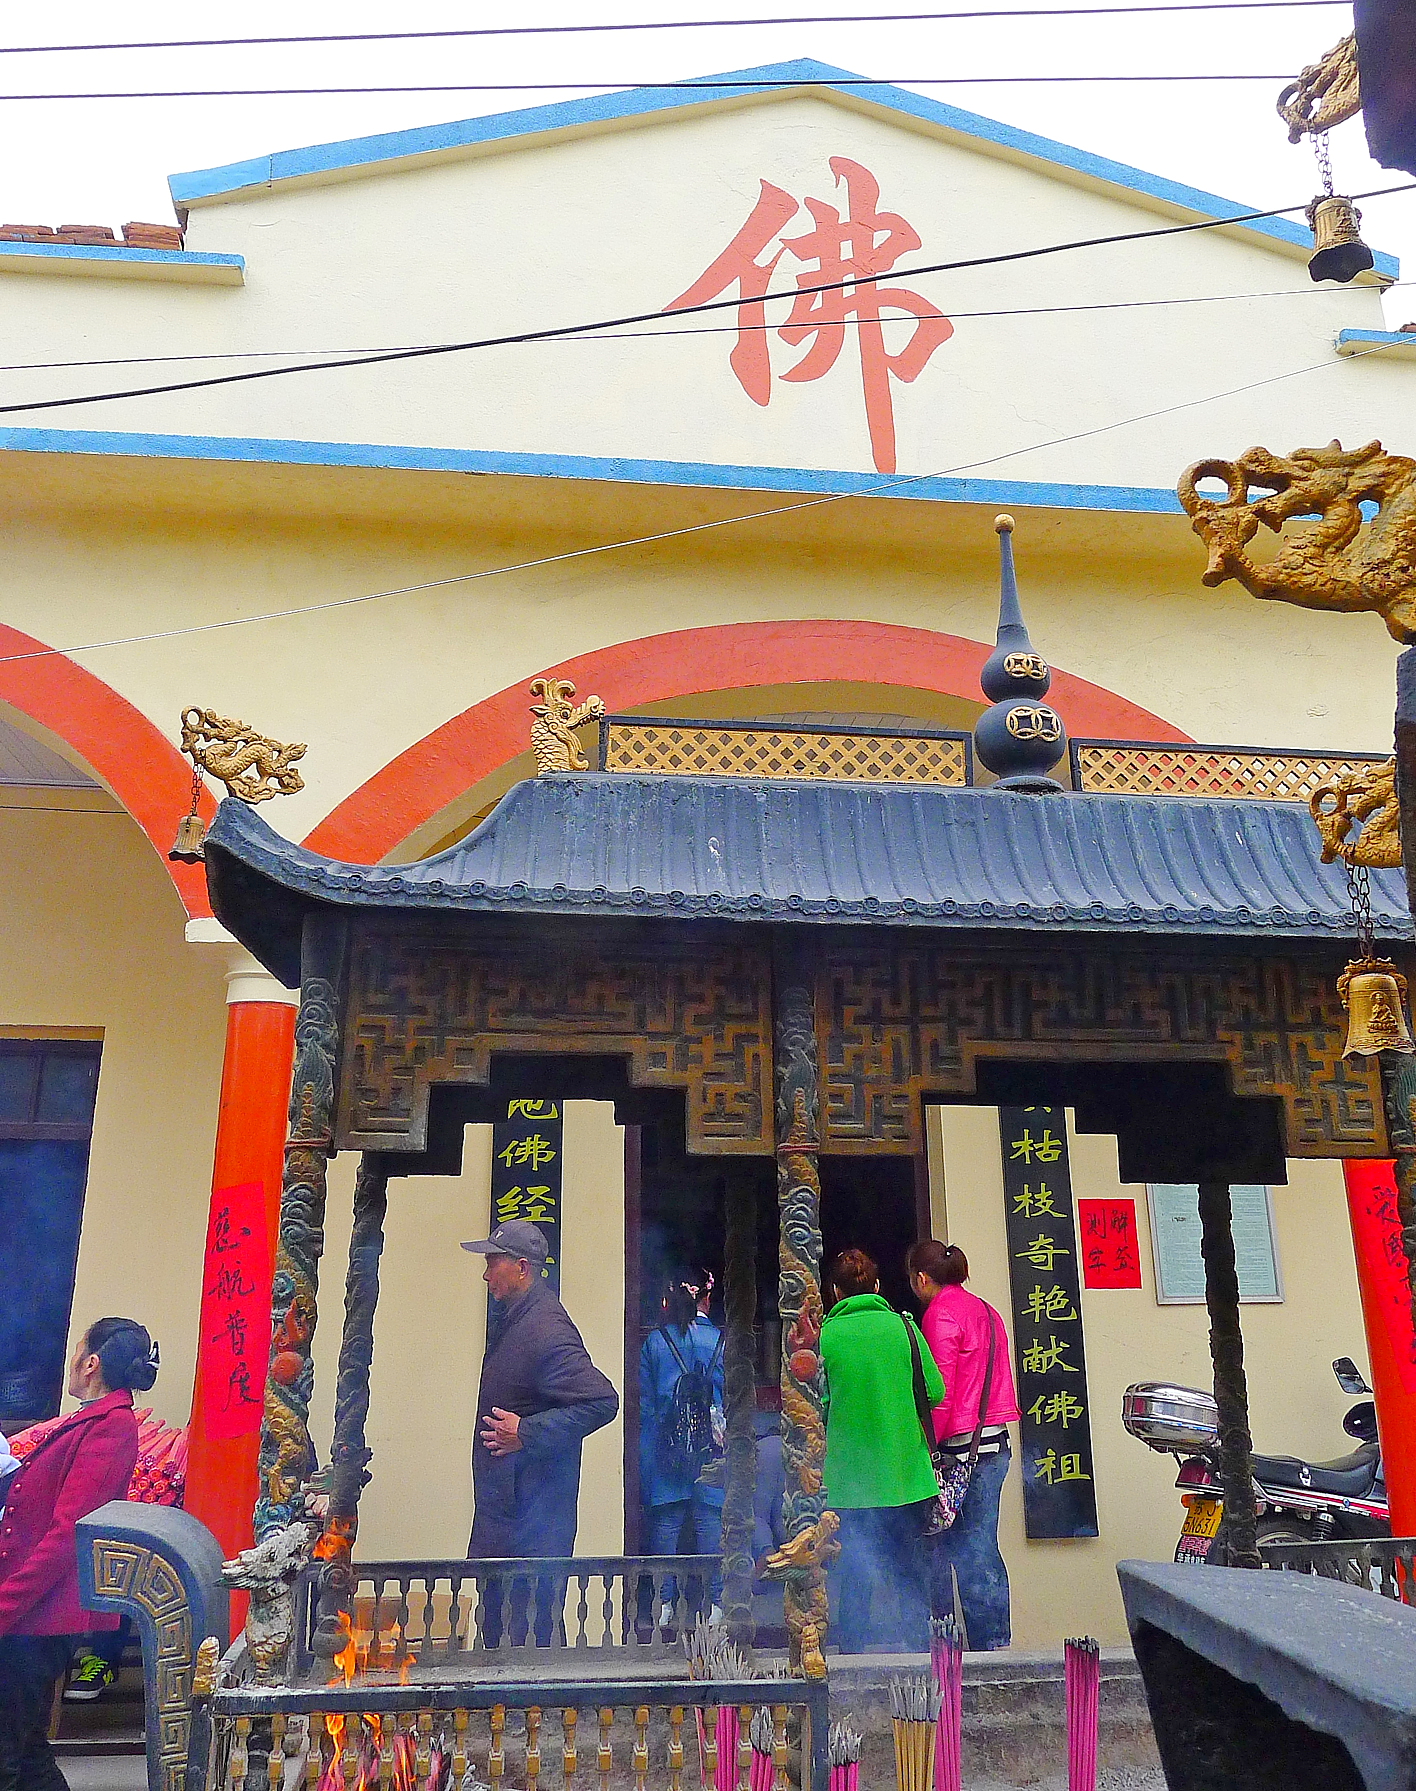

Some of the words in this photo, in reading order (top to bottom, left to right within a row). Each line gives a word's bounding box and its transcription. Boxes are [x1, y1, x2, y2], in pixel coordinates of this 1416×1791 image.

[661, 155, 955, 475] 佛
[495, 1099, 559, 1278] 佛经
[1009, 1106, 1092, 1485] 枯枝奇艳献佛祖
